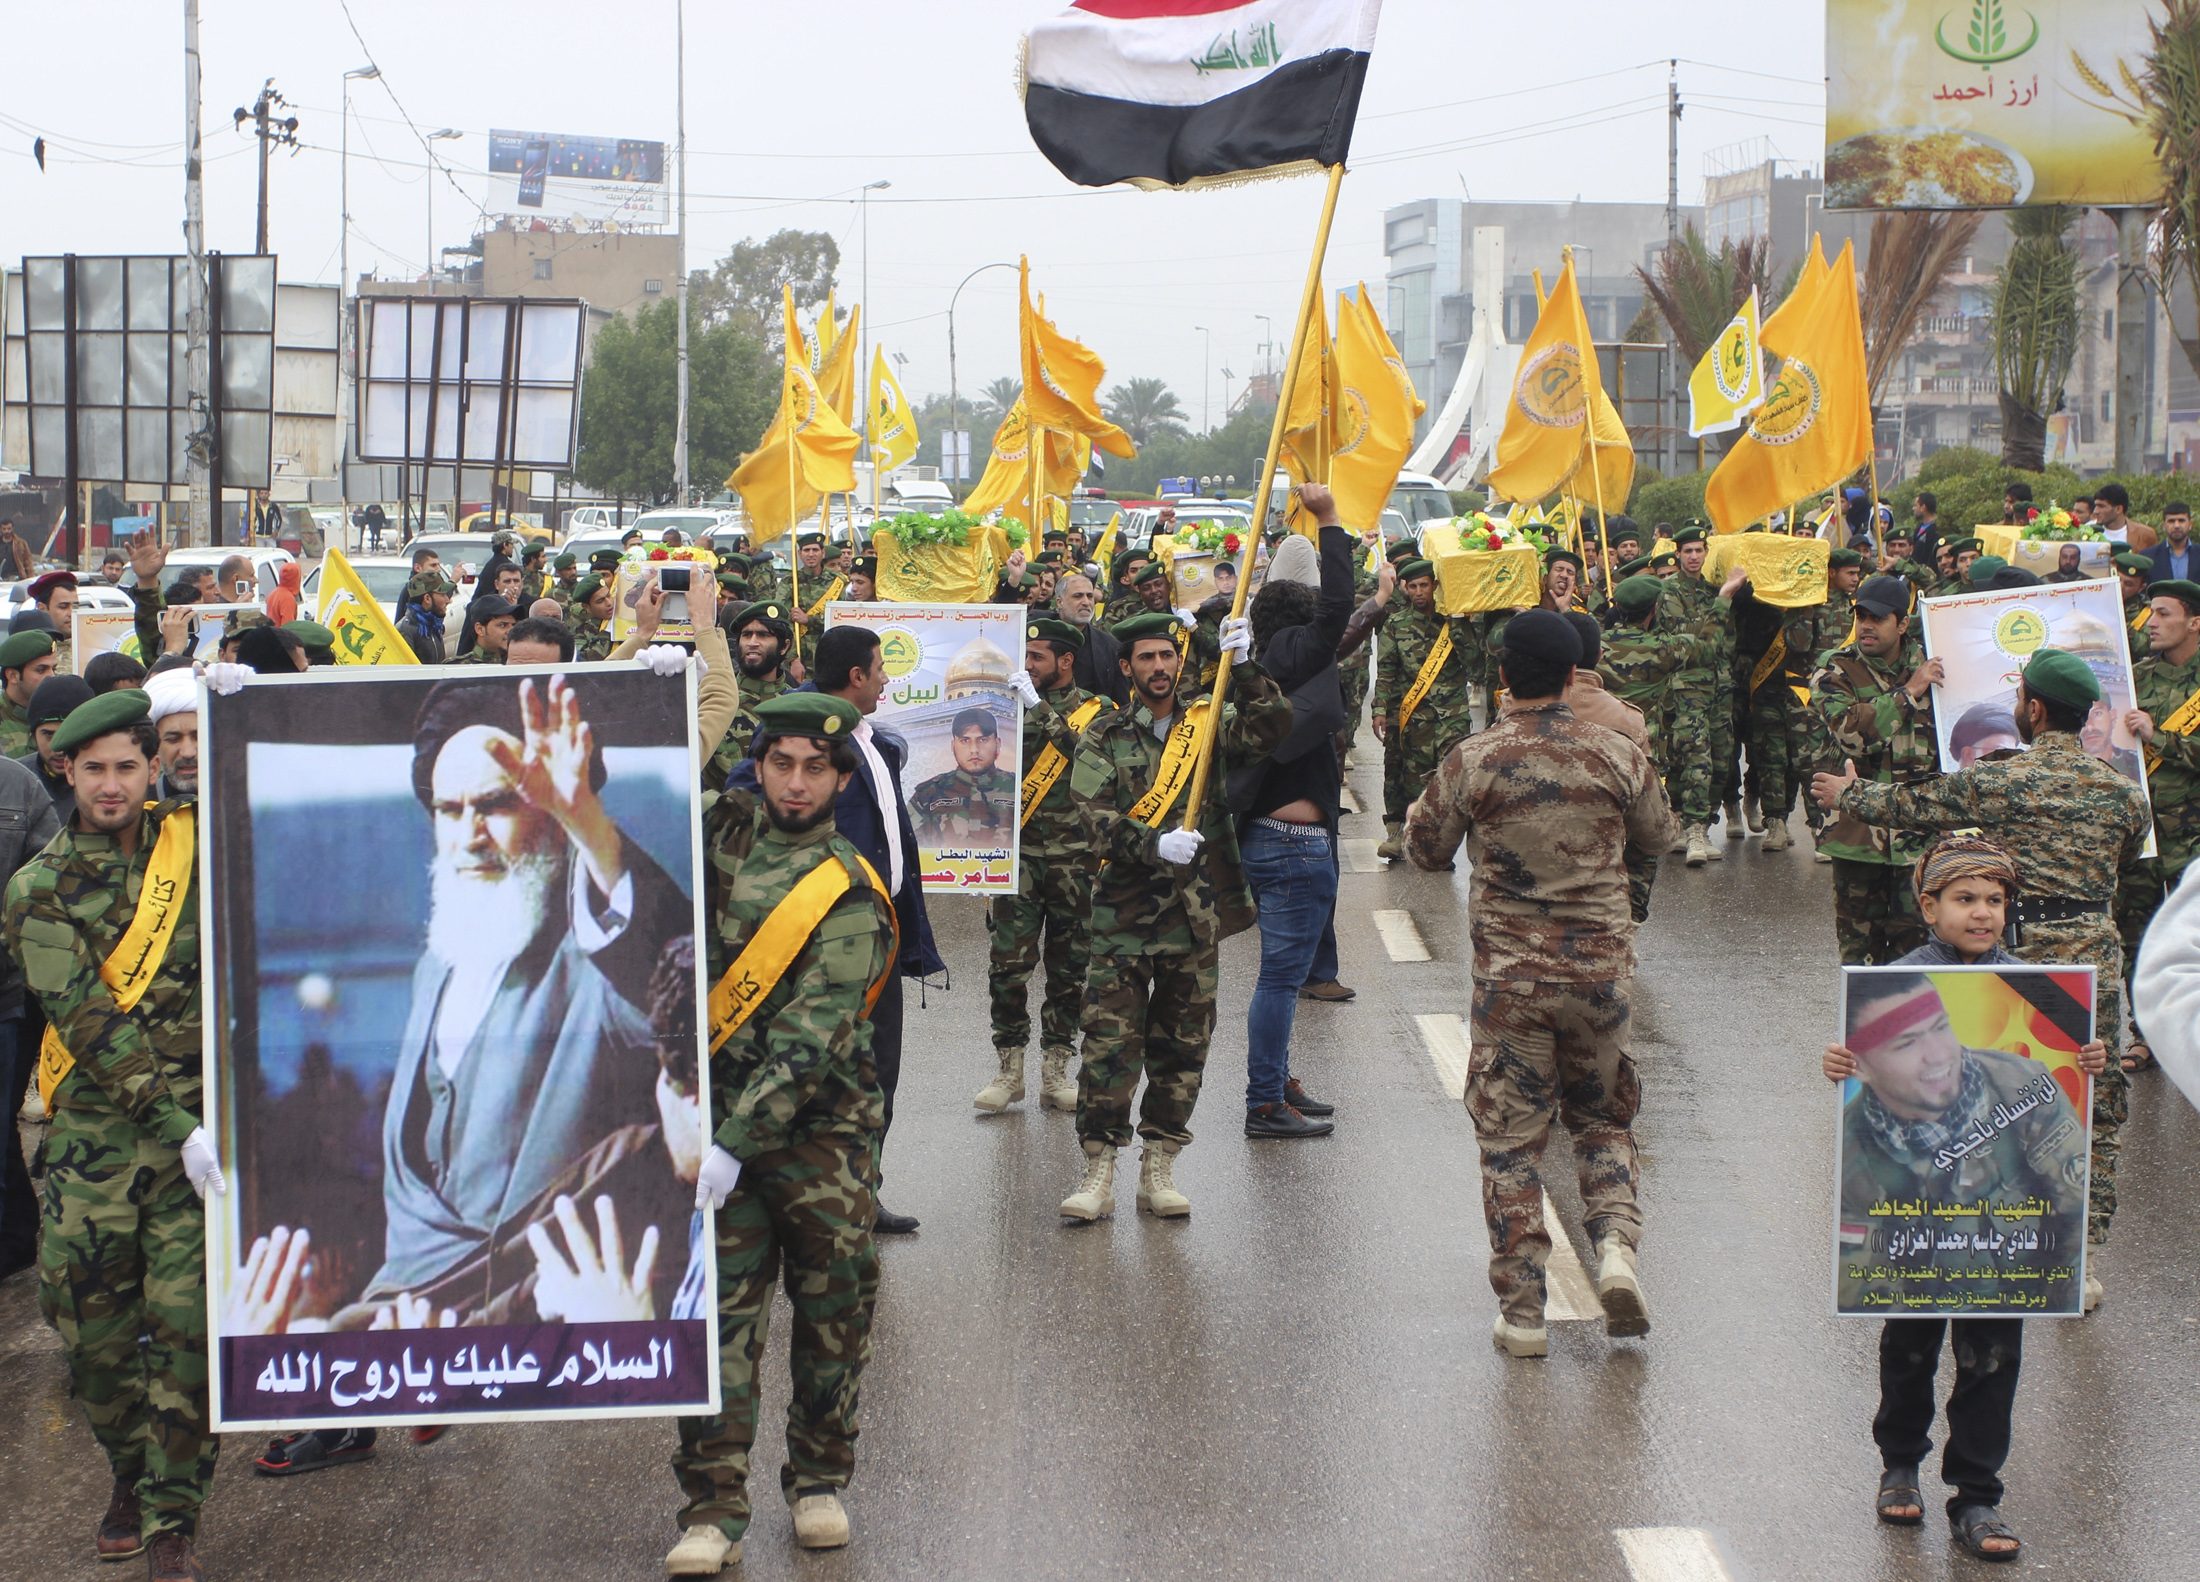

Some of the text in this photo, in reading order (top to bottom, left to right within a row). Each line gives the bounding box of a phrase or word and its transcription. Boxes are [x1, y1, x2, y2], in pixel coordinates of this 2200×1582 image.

[1932, 74, 1994, 101] أحمد
[496, 136, 523, 145] SONY
[833, 609, 866, 621] مرتين
[866, 610, 894, 622] زينب
[926, 610, 944, 622] لن
[955, 611, 993, 622] الحسين
[994, 611, 1009, 622] ورب
[892, 683, 939, 706] لبيك
[1174, 717, 1196, 760] كتائب
[1039, 753, 1061, 783] سيد
[1164, 760, 1183, 796] سيد
[935, 847, 1010, 863] الشهيد البطل
[959, 866, 1010, 887] سامر
[122, 873, 177, 987] كتائب سيد
[721, 968, 762, 1026] كتائب
[2033, 1072, 2058, 1104] لن
[1868, 1195, 2051, 1221] الشهيد السعيد المجاهد
[1888, 1226, 1935, 1261] العزاوي
[1937, 1228, 1969, 1251] محمد
[1971, 1226, 2005, 1257] جاسم
[2007, 1224, 2039, 1261] هادي
[1848, 1264, 2075, 1284] الذي استشهد دفاعا عن العقيدة والكرامة
[1862, 1290, 2048, 1309] ومرقد السيدة زينب عليها السلام
[255, 1350, 321, 1395] الله
[442, 1342, 542, 1400] عليك
[547, 1337, 673, 1389] السلام
